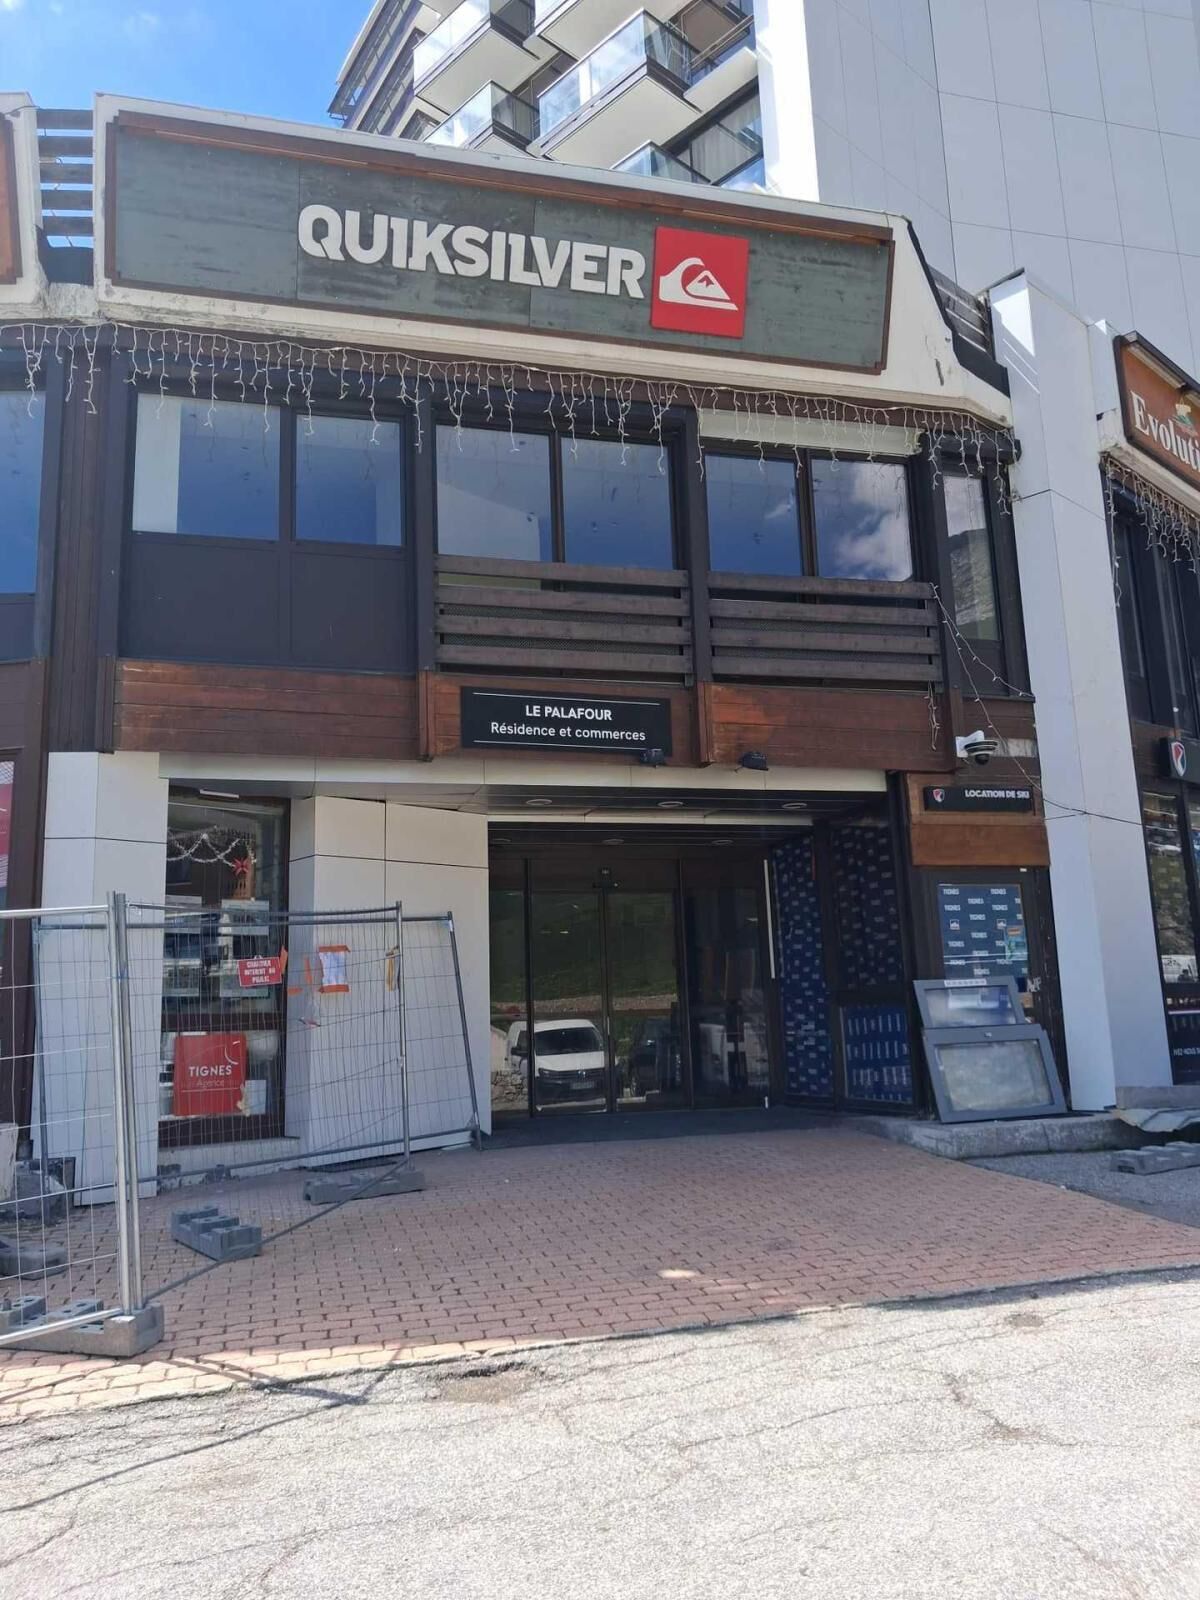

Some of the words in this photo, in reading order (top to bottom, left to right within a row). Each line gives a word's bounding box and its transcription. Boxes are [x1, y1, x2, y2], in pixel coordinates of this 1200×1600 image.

[299, 204, 646, 299] QUIKSILVER
[525, 704, 541, 717] LE
[544, 706, 612, 721] PALAFOUR
[491, 722, 556, 737] Résidence
[559, 726, 572, 737] et
[575, 729, 646, 741] commerces
[965, 789, 1005, 798] LOCATION
[1006, 790, 1016, 798] DE
[1016, 790, 1030, 799] SKI
[189, 1065, 232, 1077] TIGNES
